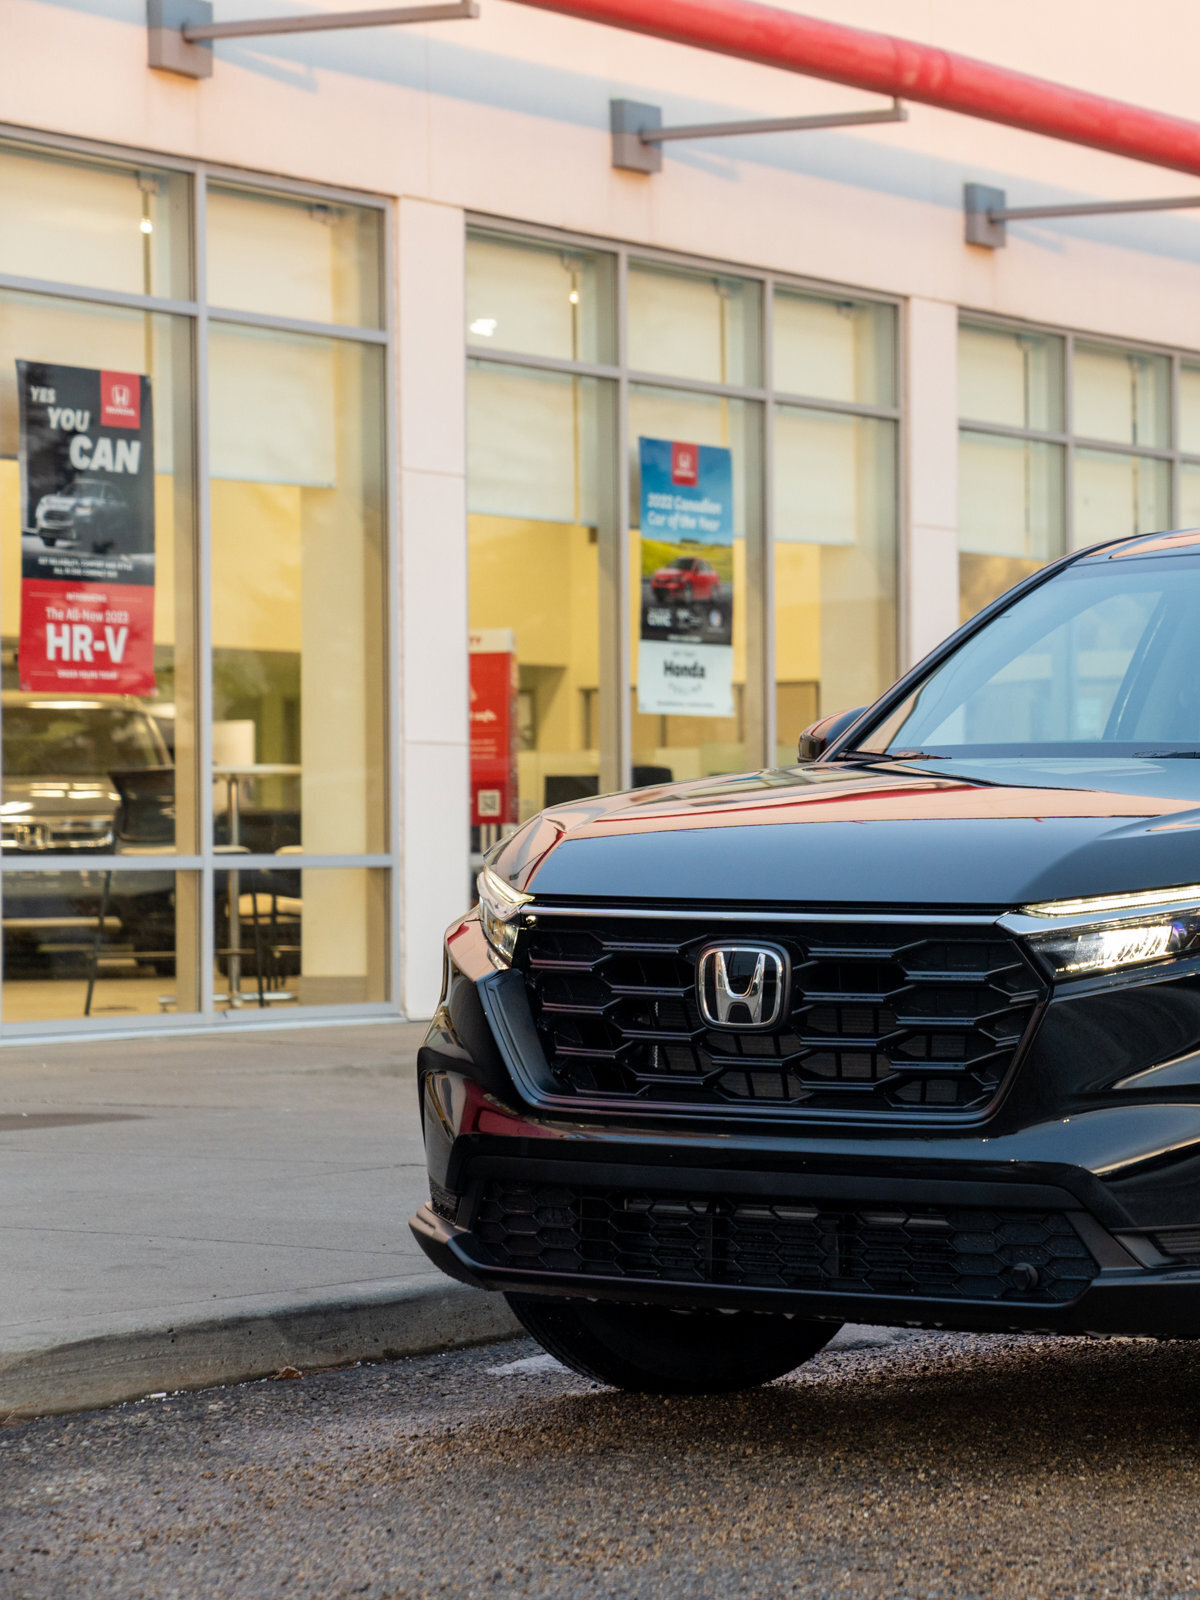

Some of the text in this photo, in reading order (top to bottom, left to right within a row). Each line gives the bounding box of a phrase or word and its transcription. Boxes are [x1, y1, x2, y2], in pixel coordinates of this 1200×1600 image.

[30, 385, 56, 404] YES
[48, 406, 91, 433] YOU
[69, 433, 141, 475] CAN
[45, 606, 64, 621] The
[46, 623, 129, 665] HR-V
[663, 659, 706, 680] Honda
